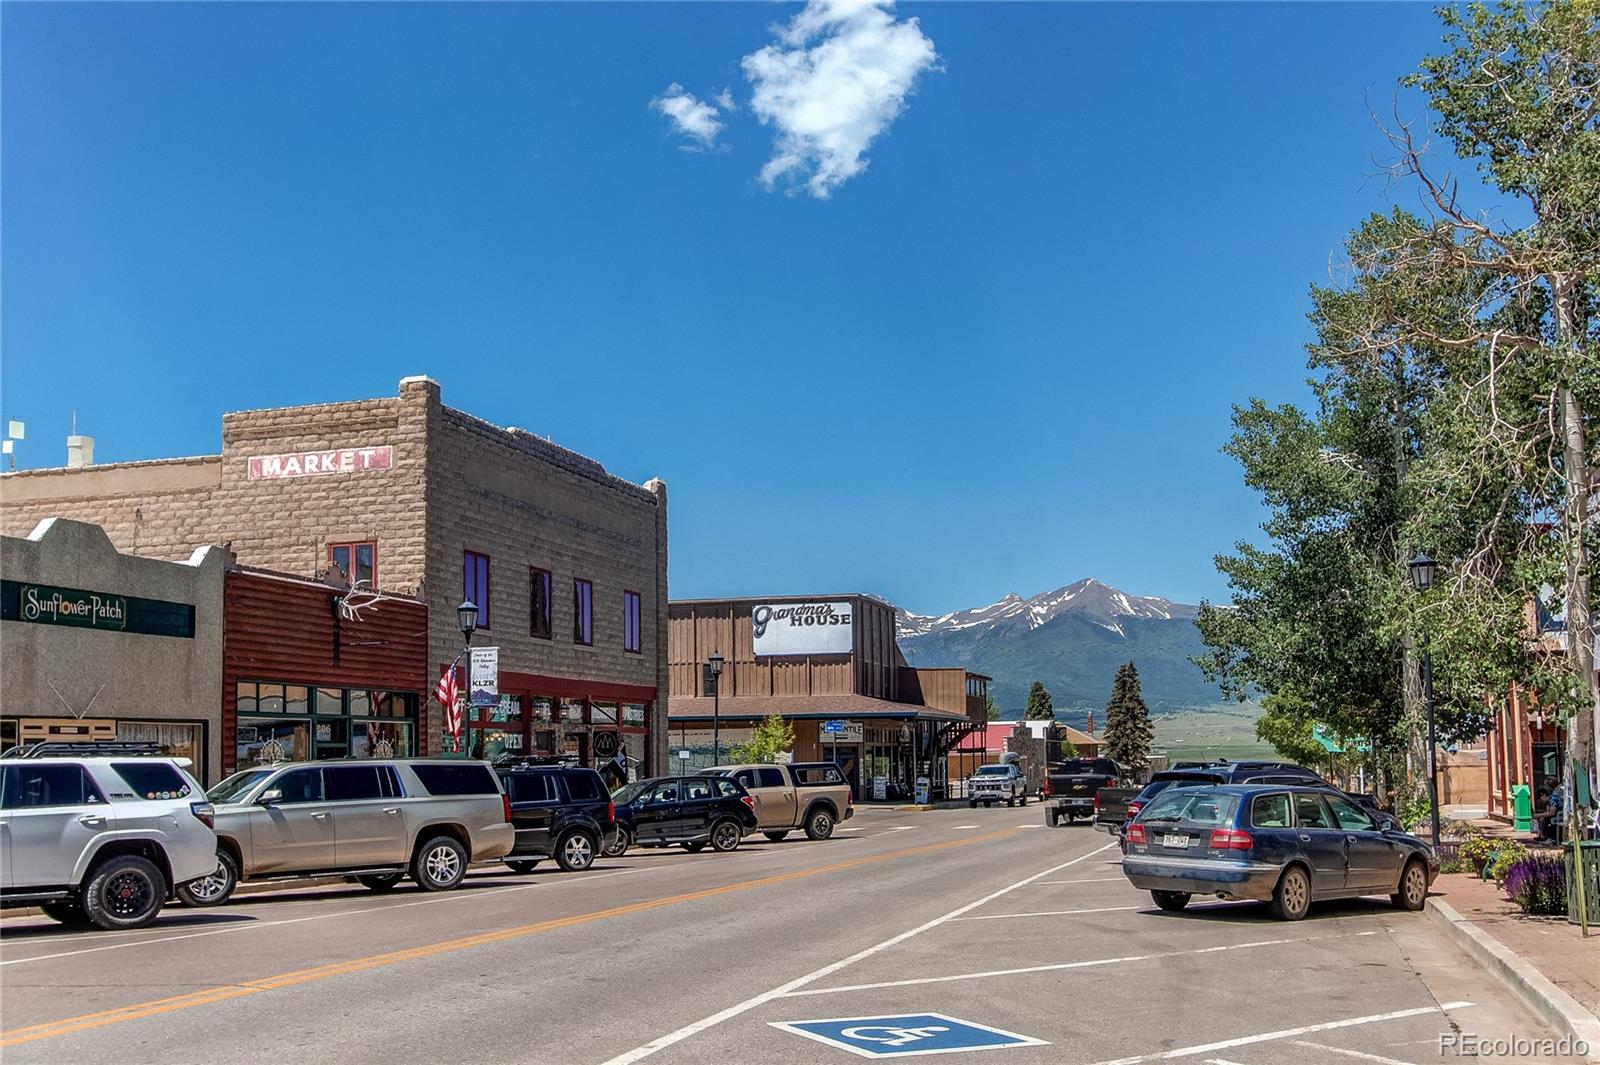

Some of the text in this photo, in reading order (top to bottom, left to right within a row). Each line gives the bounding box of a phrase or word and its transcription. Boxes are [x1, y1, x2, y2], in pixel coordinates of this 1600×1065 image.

[262, 450, 375, 477] MARKET
[25, 588, 122, 625] Sunflower Patch
[789, 613, 851, 627] HOUSE
[752, 603, 835, 638] Grandma's
[504, 734, 523, 749] OPEN
